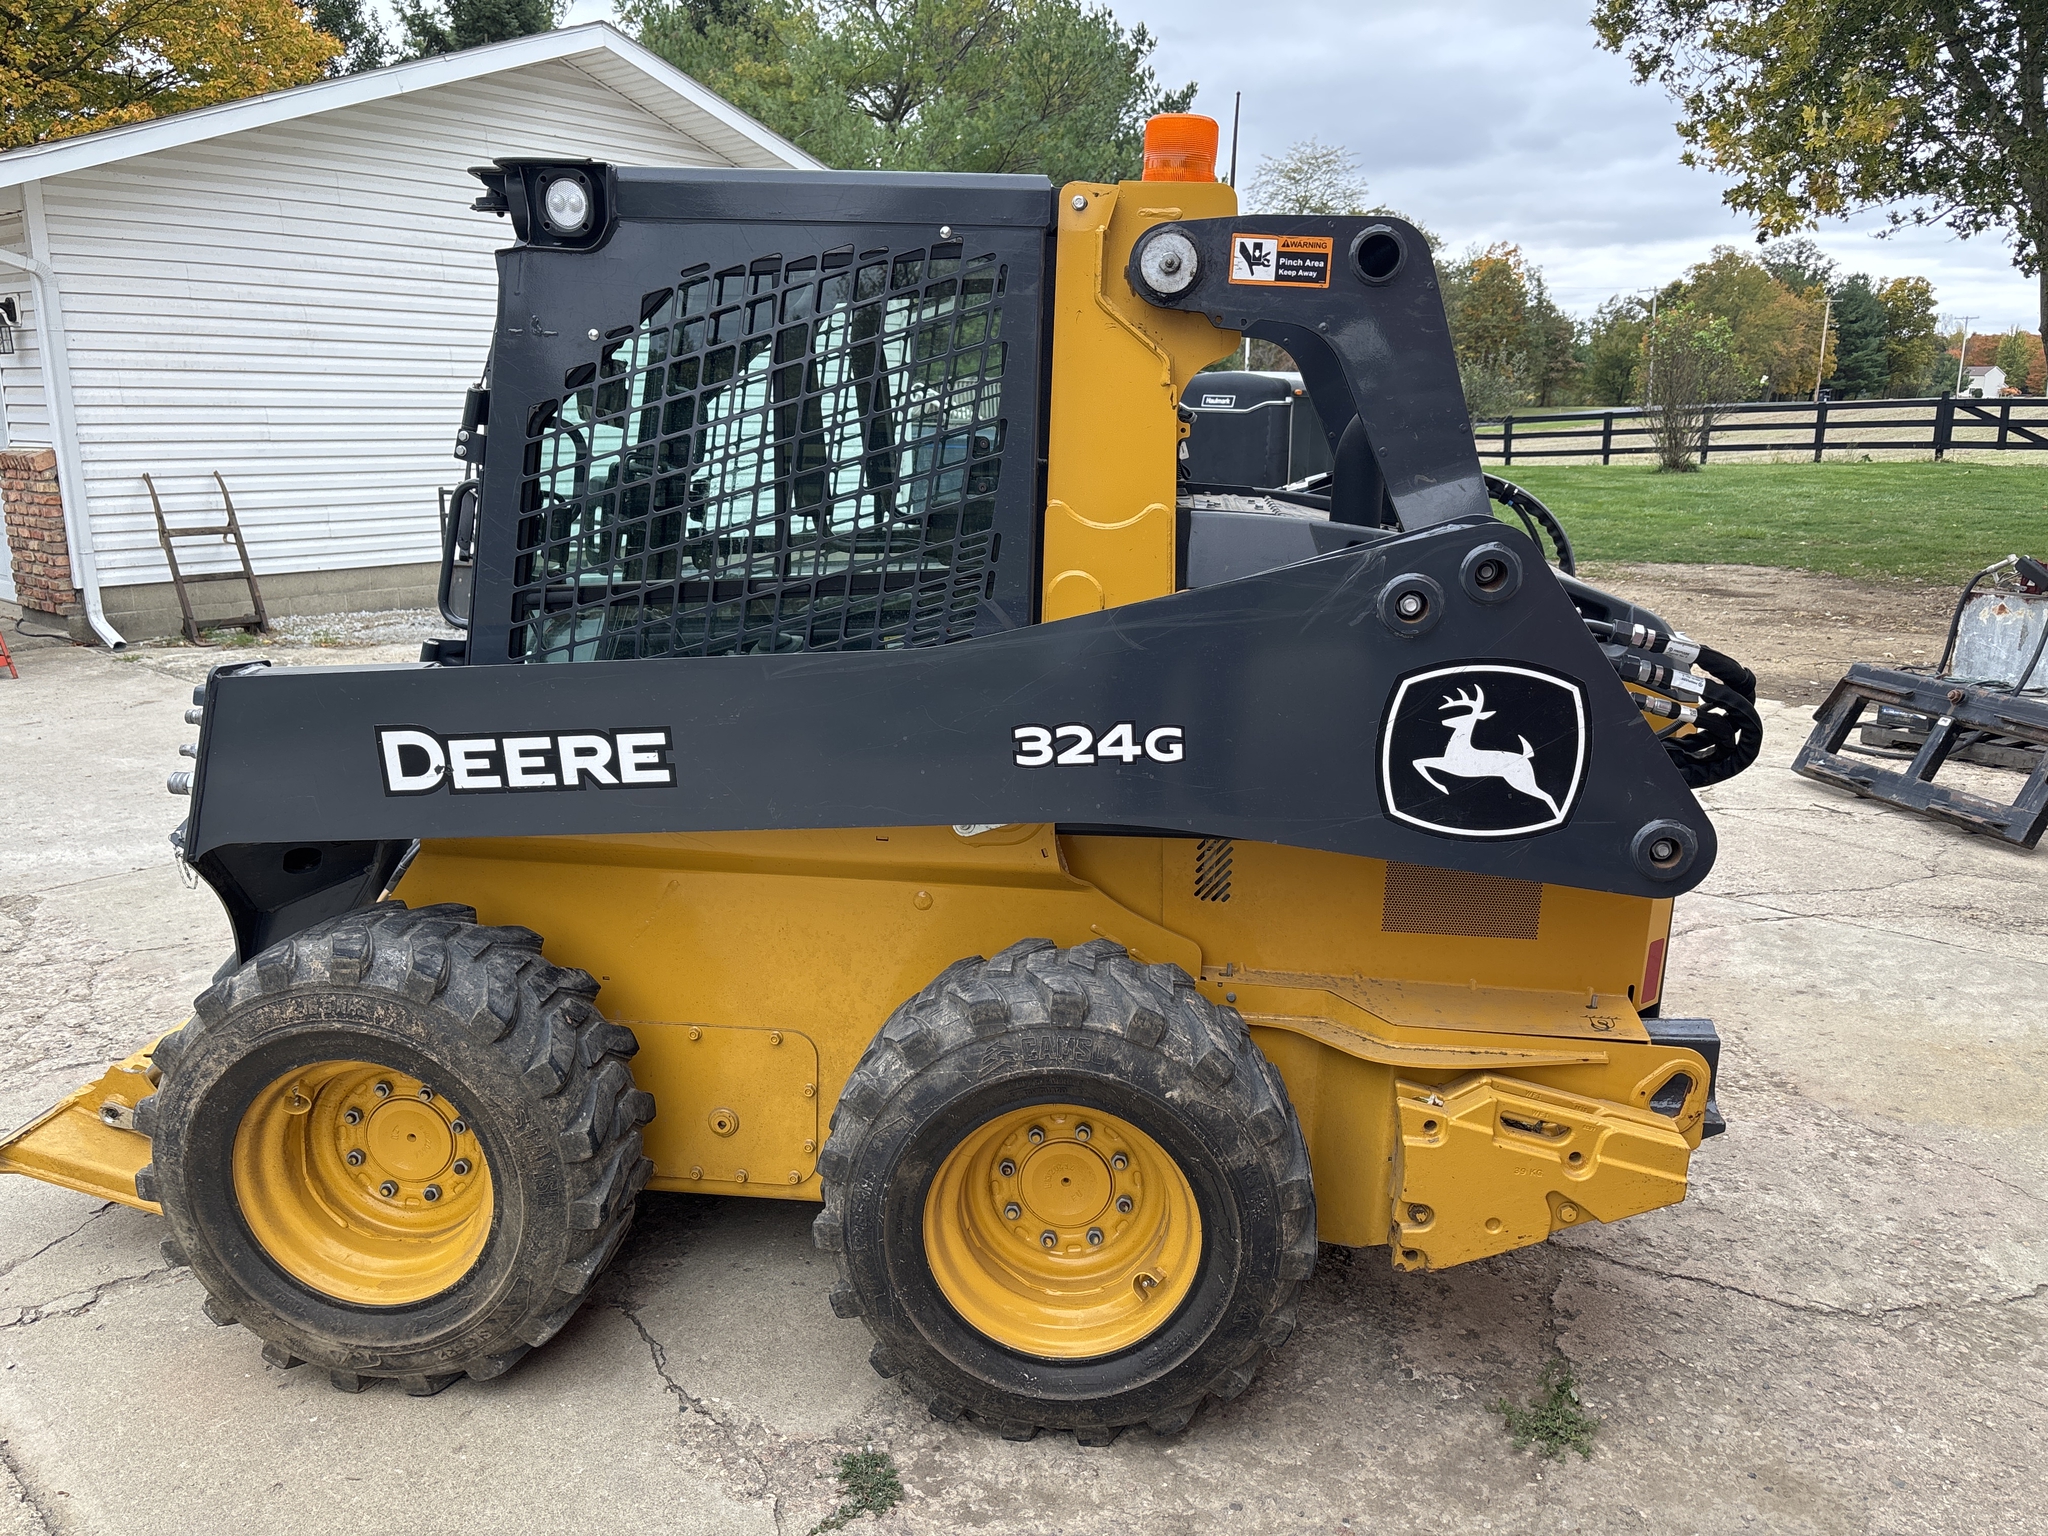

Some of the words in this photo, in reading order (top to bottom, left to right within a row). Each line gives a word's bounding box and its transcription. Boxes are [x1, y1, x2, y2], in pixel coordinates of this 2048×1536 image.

[1290, 240, 1328, 249] WARNING
[1279, 257, 1303, 267] Pinch
[1304, 259, 1325, 267] Area
[1278, 268, 1297, 277] Keep
[1298, 270, 1317, 278] Away
[1013, 723, 1184, 766] 324G
[380, 729, 671, 792] DEERE
[1513, 1166, 1527, 1176] 39
[1529, 1167, 1545, 1179] KG
